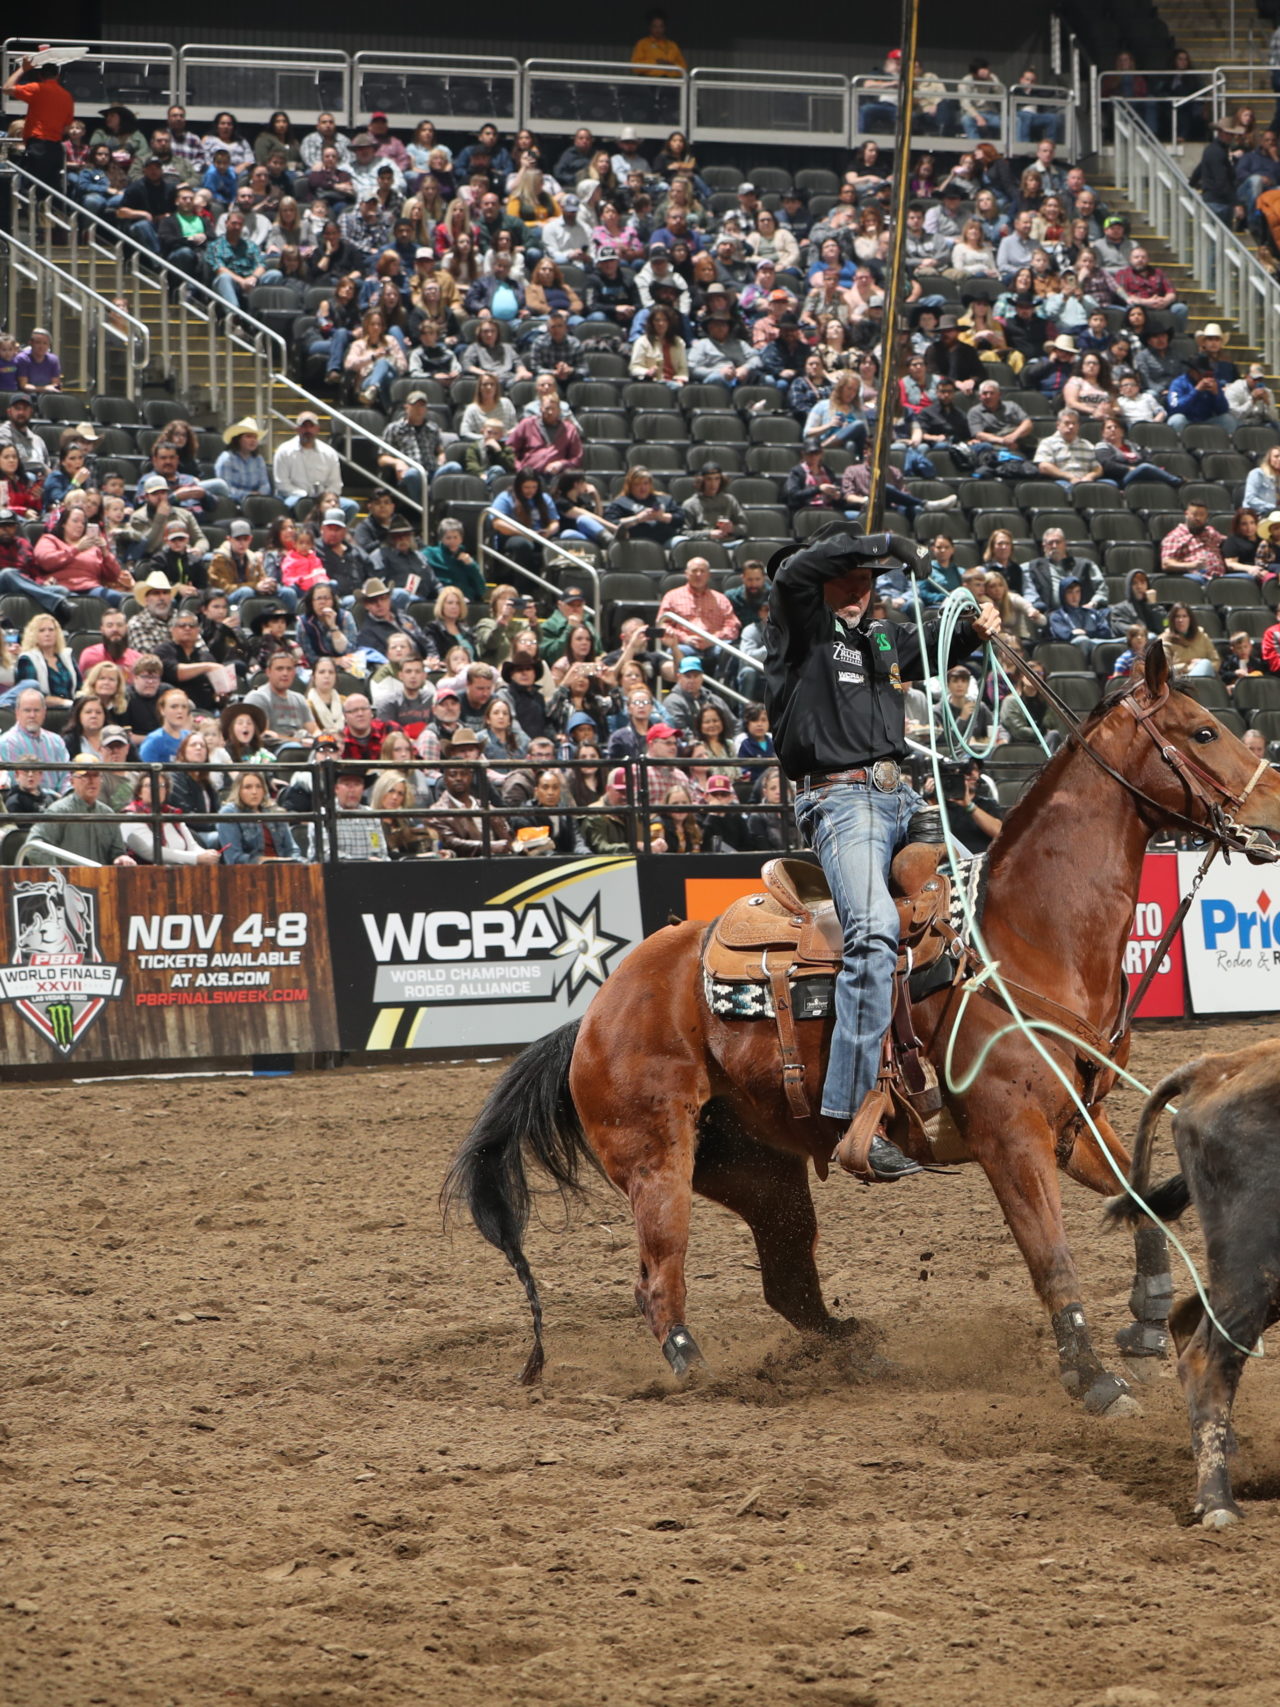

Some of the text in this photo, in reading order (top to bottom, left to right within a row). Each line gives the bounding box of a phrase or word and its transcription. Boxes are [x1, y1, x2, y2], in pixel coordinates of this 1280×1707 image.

[1129, 902, 1163, 937] TO
[127, 912, 308, 950] NOV 4-8
[361, 909, 558, 962] WCRA
[34, 954, 79, 965] PBR
[138, 951, 301, 968] TICKETS AVAILABLE
[1121, 940, 1171, 974] RTS
[1217, 950, 1252, 971] Rodeo
[1256, 951, 1271, 971] &
[5, 968, 112, 982] WORLD FINALS
[171, 971, 271, 988] AT AXS.COM
[390, 966, 542, 983] WORLD CHAMPIONS
[37, 981, 82, 992] XXVII
[404, 981, 531, 998] RODEO ALLIANCE
[136, 989, 309, 1006] PBRFINALSWEEK.COM
